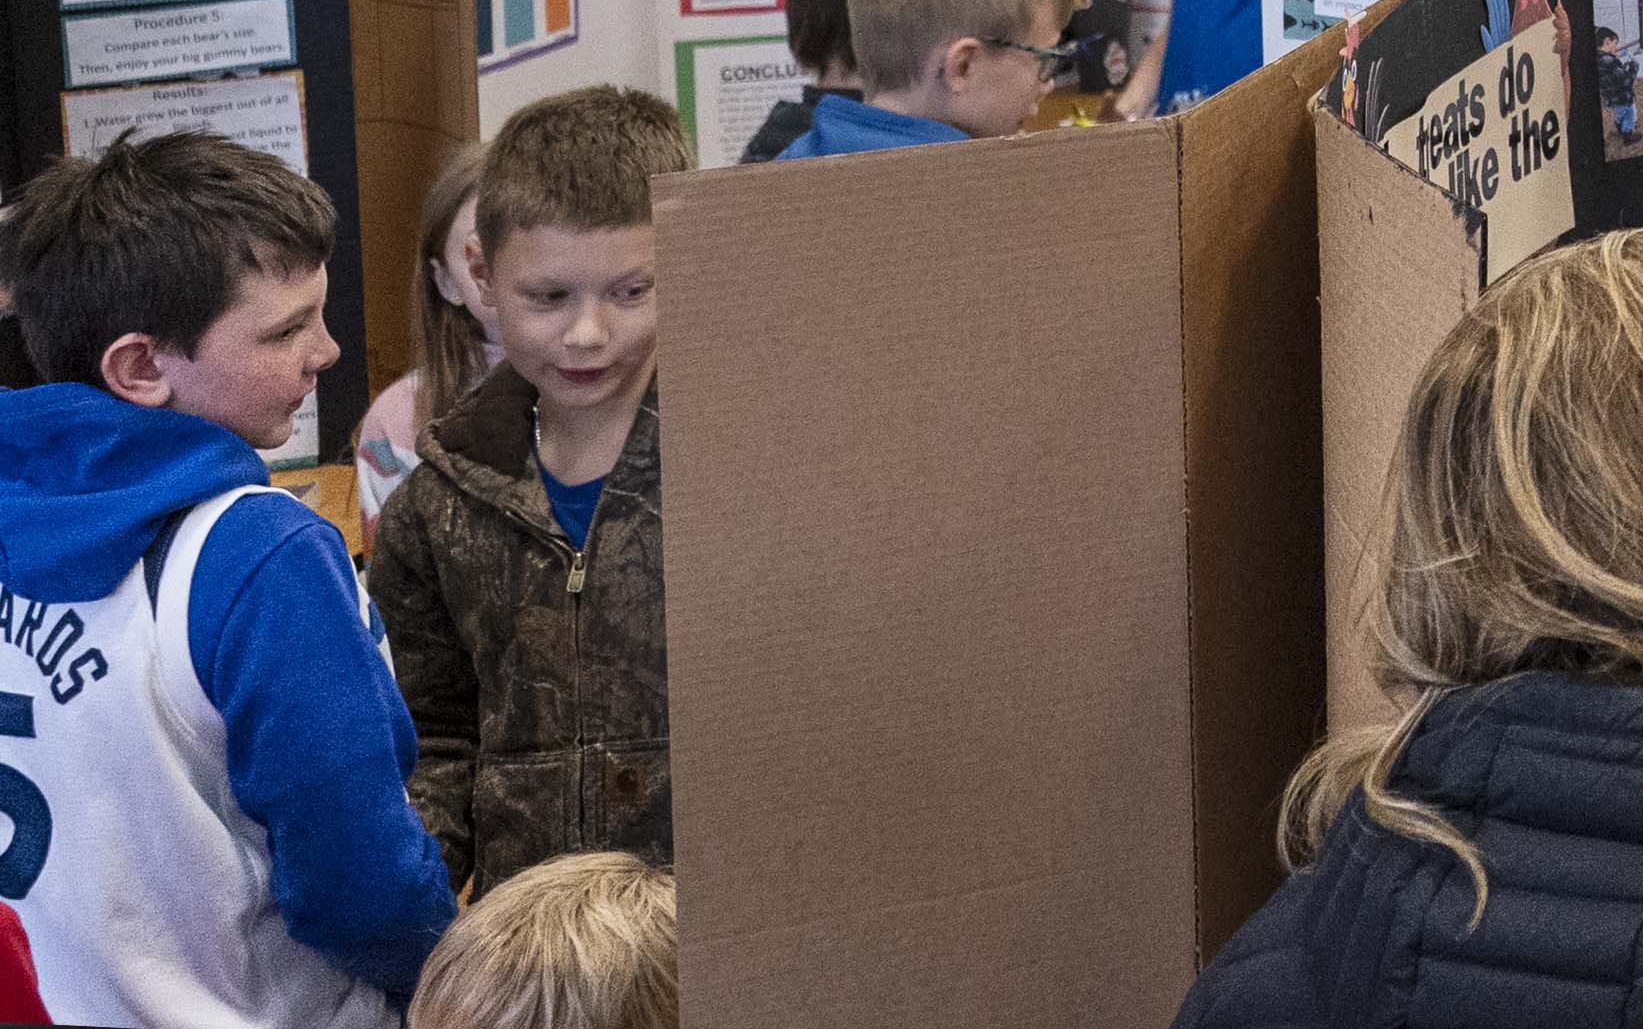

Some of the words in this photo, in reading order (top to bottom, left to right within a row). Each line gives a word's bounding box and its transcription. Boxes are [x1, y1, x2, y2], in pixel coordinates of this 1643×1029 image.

[721, 63, 797, 81] CONCLU
[1499, 46, 1534, 118] do
[1449, 148, 1499, 208] like
[1509, 109, 1560, 182] the
[0, 585, 108, 705] ARDS
